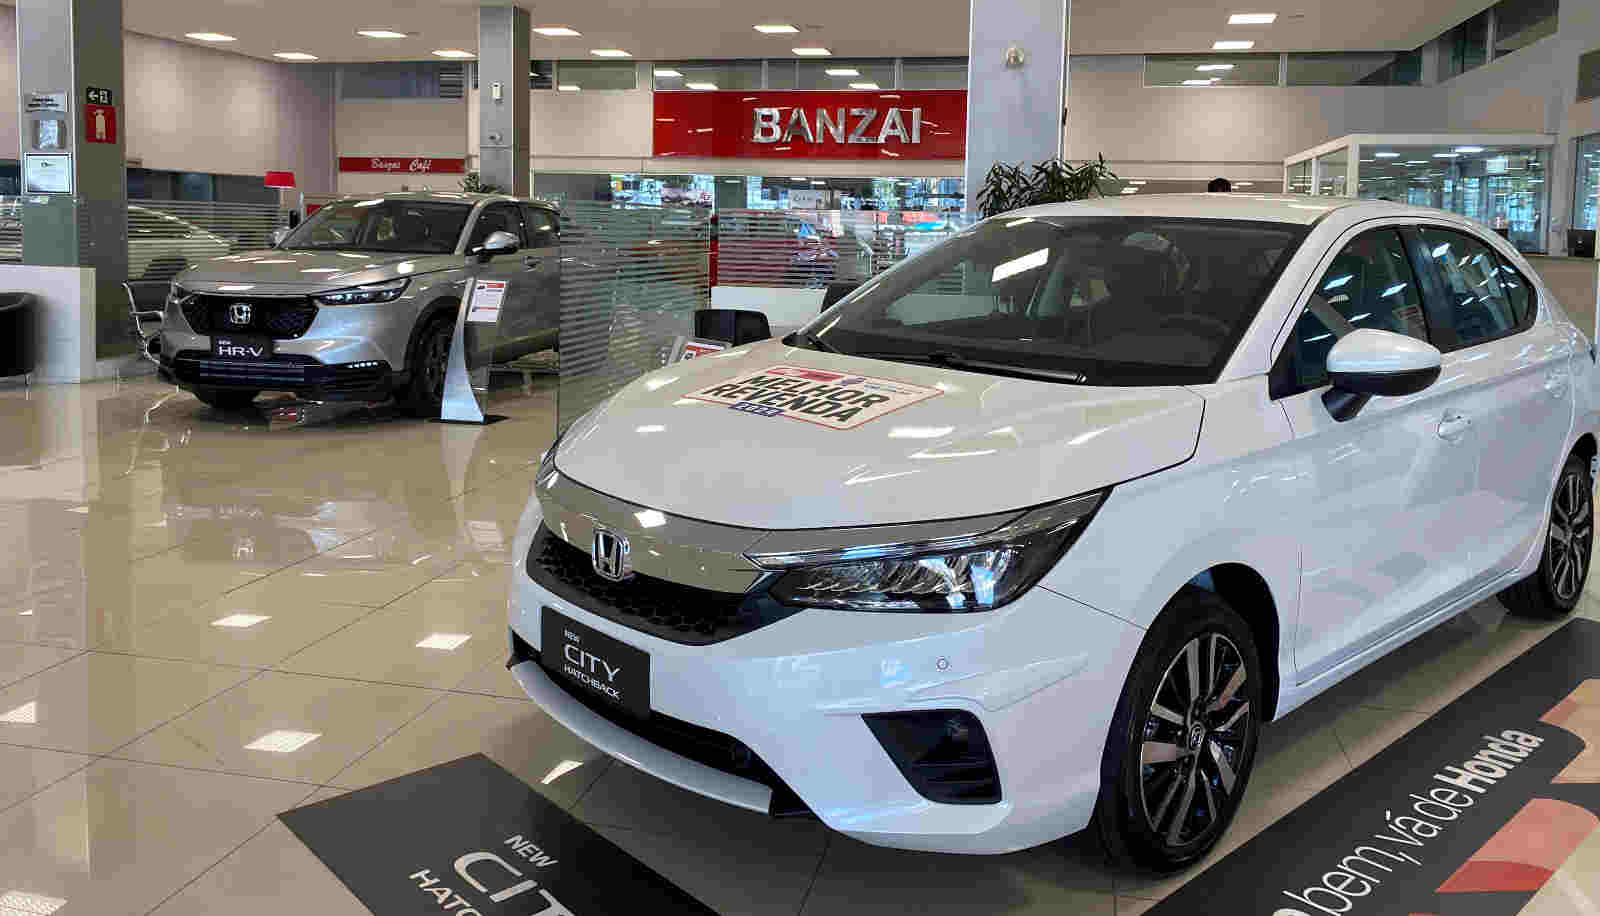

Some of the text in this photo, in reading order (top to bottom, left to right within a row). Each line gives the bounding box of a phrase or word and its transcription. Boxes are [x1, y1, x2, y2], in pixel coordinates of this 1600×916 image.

[751, 107, 922, 144] BANZAI
[218, 346, 264, 357] HR-V
[702, 383, 863, 422] REVENDA
[738, 375, 890, 408] MELHOR
[563, 643, 621, 682] CITY
[563, 662, 621, 701] HATCHBACK
[1432, 729, 1545, 794] Honda
[504, 834, 559, 868] NEW
